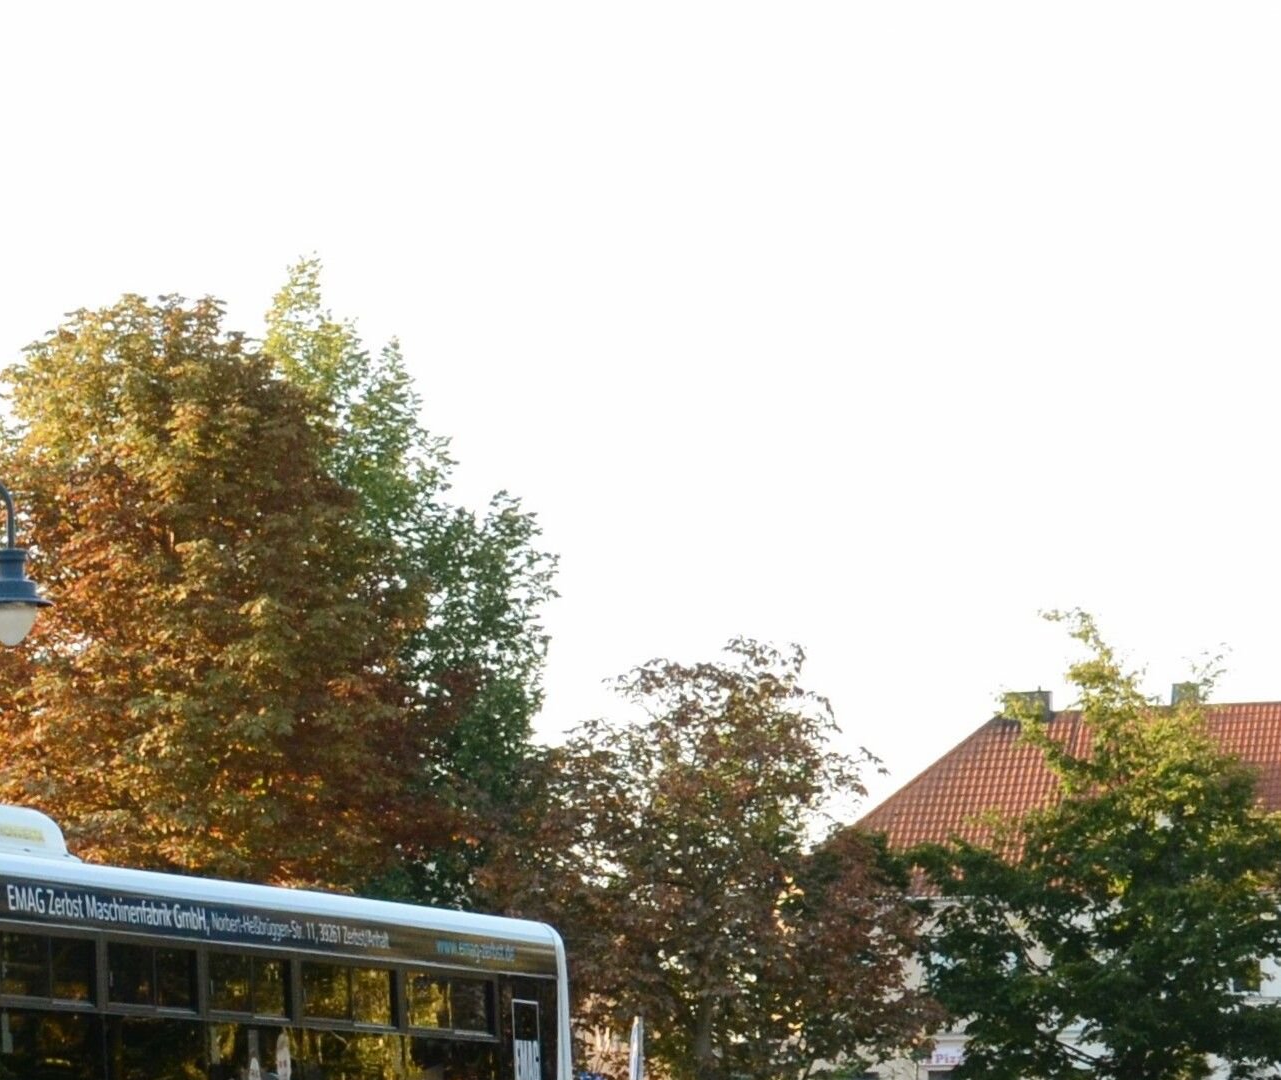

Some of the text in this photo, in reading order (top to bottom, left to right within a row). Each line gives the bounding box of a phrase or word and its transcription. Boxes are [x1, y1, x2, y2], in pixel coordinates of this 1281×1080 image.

[6, 884, 45, 914] EMAG
[46, 888, 84, 918] Zerbst
[85, 893, 172, 928] Maschinenfabrik
[173, 903, 211, 936] GmbH,
